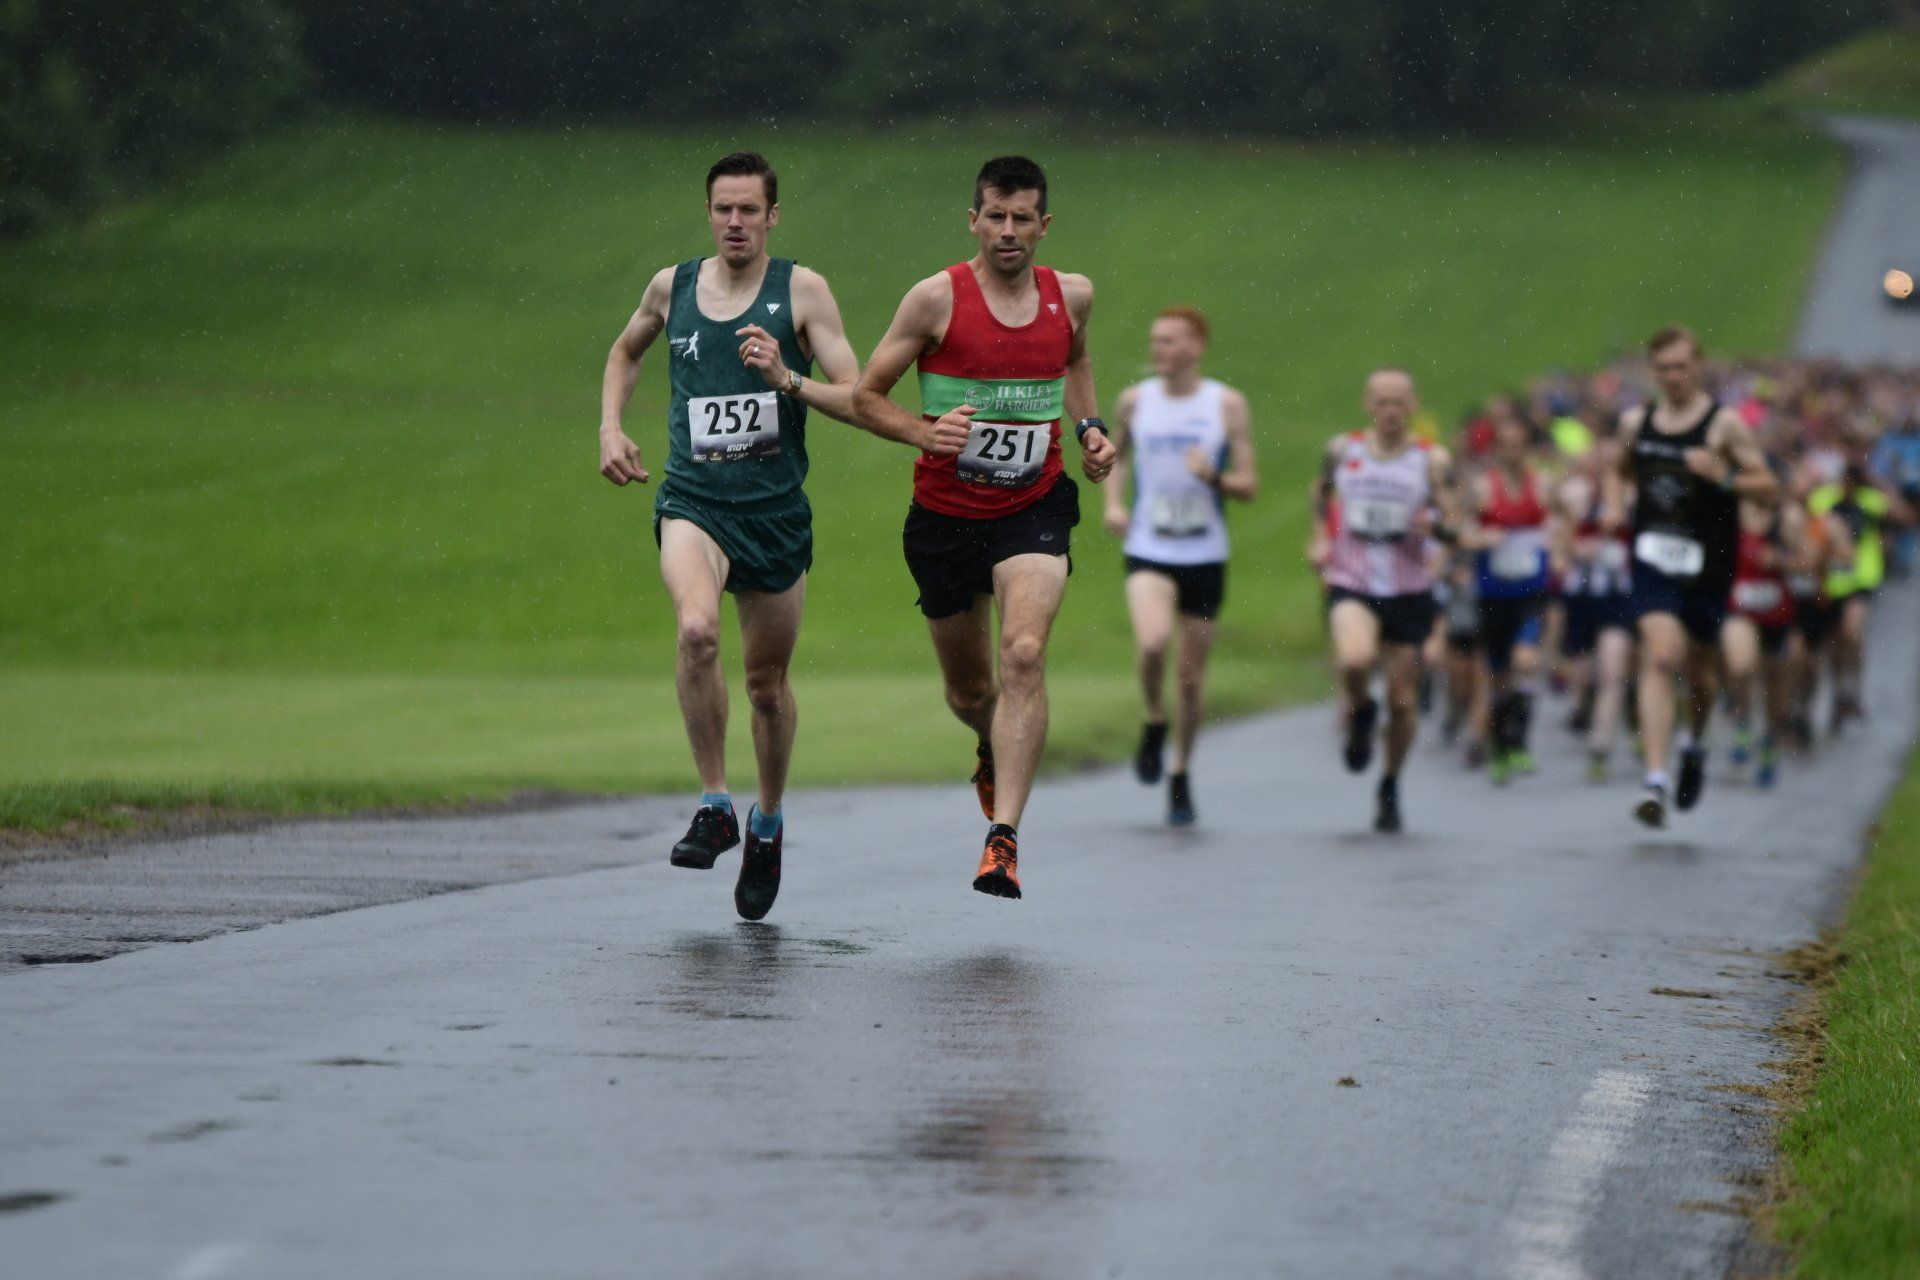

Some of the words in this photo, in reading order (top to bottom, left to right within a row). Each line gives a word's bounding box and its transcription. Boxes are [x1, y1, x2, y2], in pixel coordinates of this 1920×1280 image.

[998, 385, 1053, 398] ILKLEY
[704, 398, 762, 436] 252
[995, 399, 1051, 411] HARRIERS
[977, 427, 1035, 464] 251
